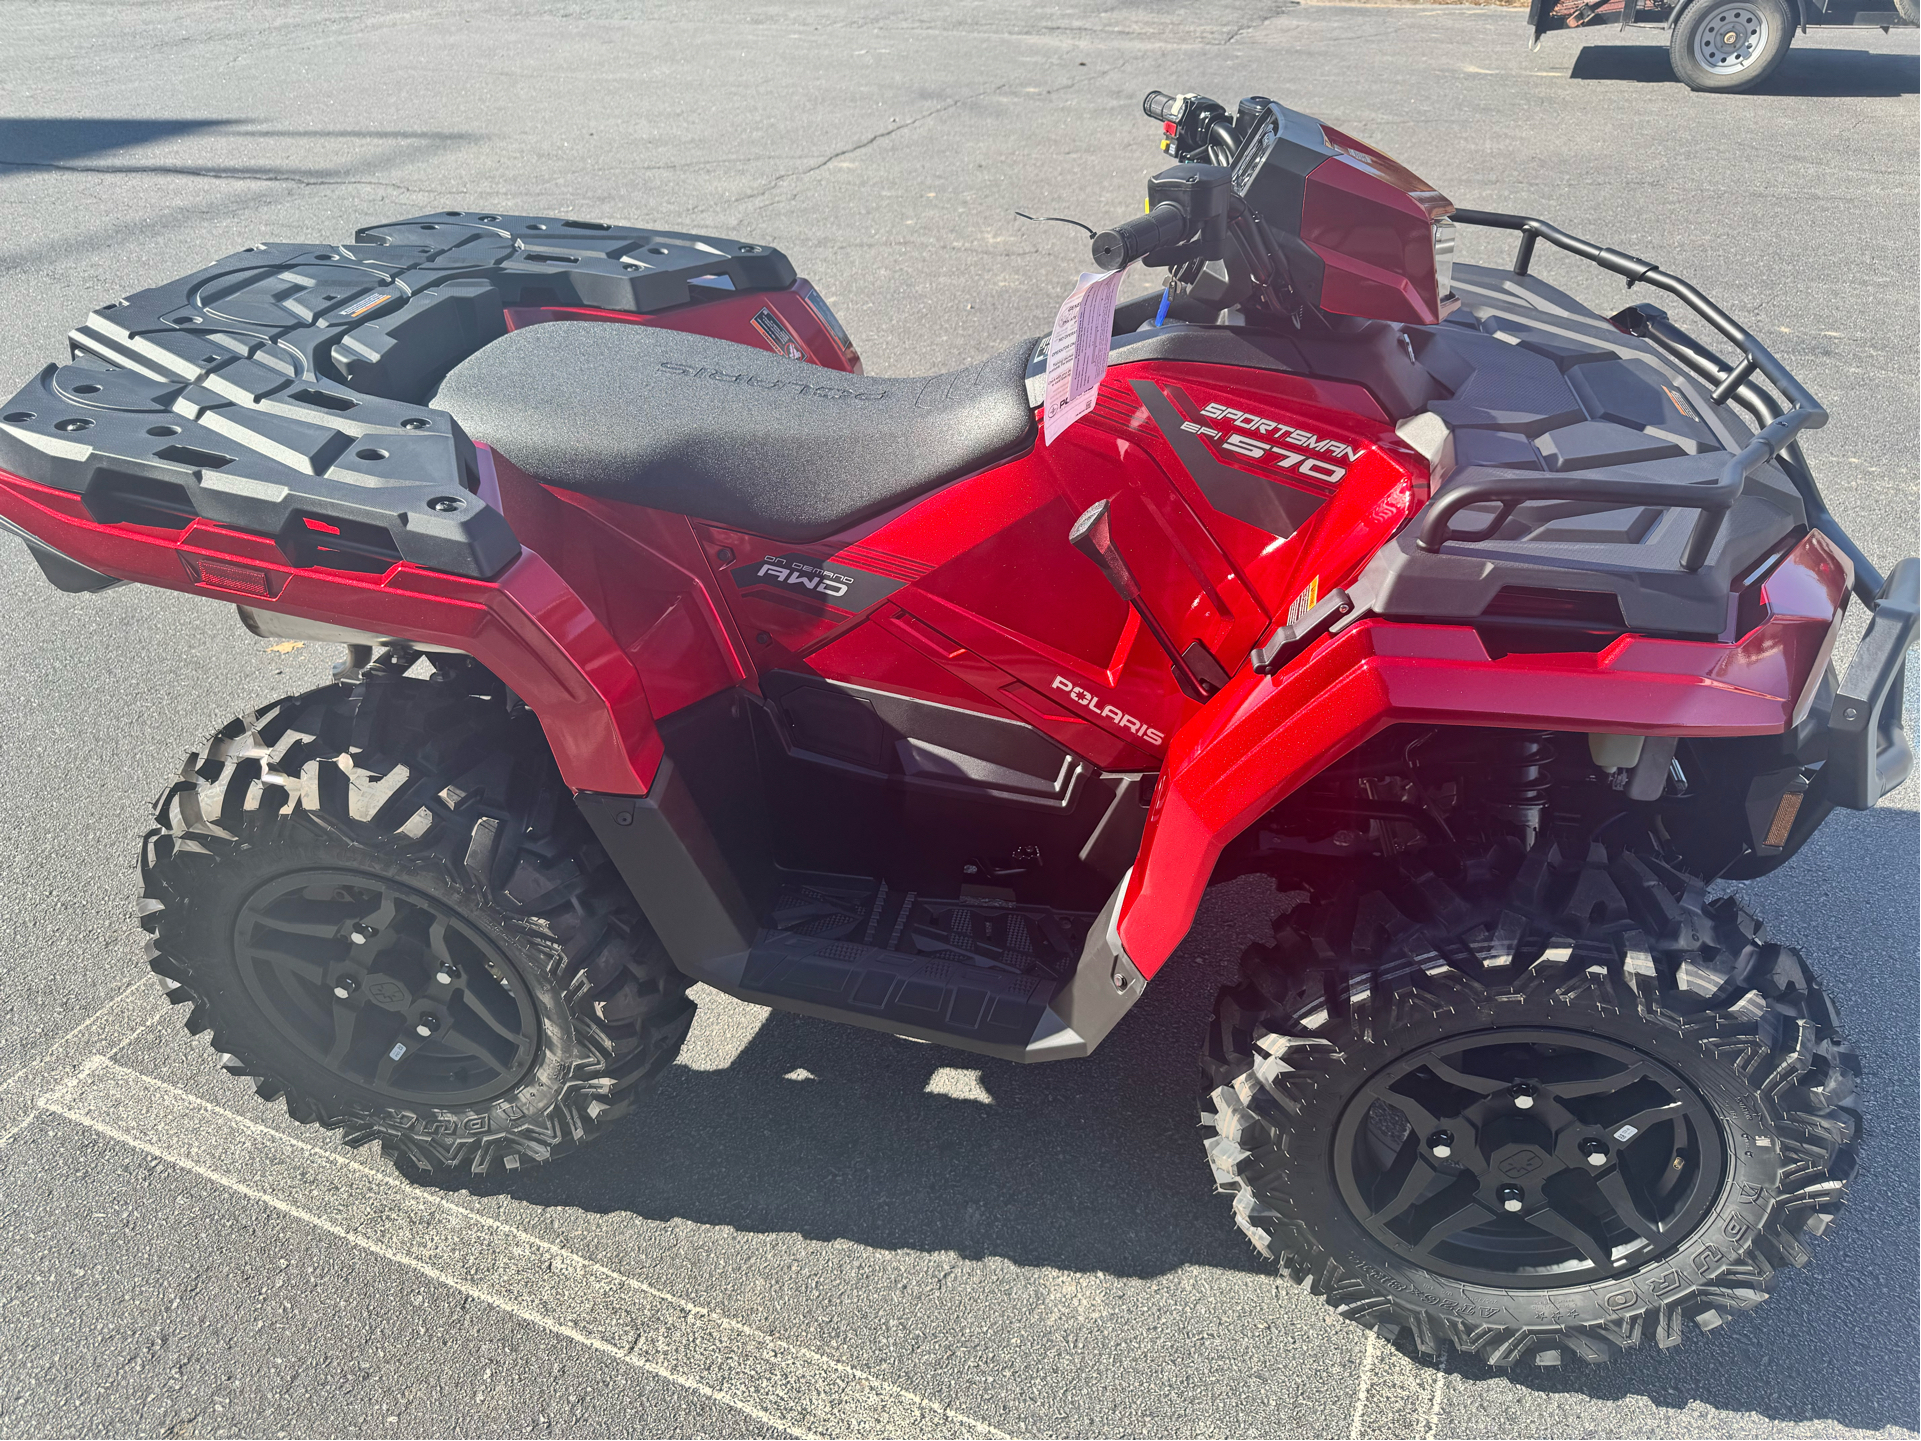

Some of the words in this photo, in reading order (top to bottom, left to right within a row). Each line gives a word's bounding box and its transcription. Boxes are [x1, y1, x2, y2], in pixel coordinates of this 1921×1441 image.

[656, 361, 888, 400] POLARIS
[1180, 421, 1222, 440] EFI
[1221, 433, 1347, 484] 570
[1200, 402, 1366, 462] SPORTSMAN
[757, 563, 848, 597] AWD
[764, 555, 786, 565] ON
[791, 562, 854, 584] DEMAND
[1051, 675, 1165, 746] POLARIS
[1604, 1210, 1750, 1310] DURO
